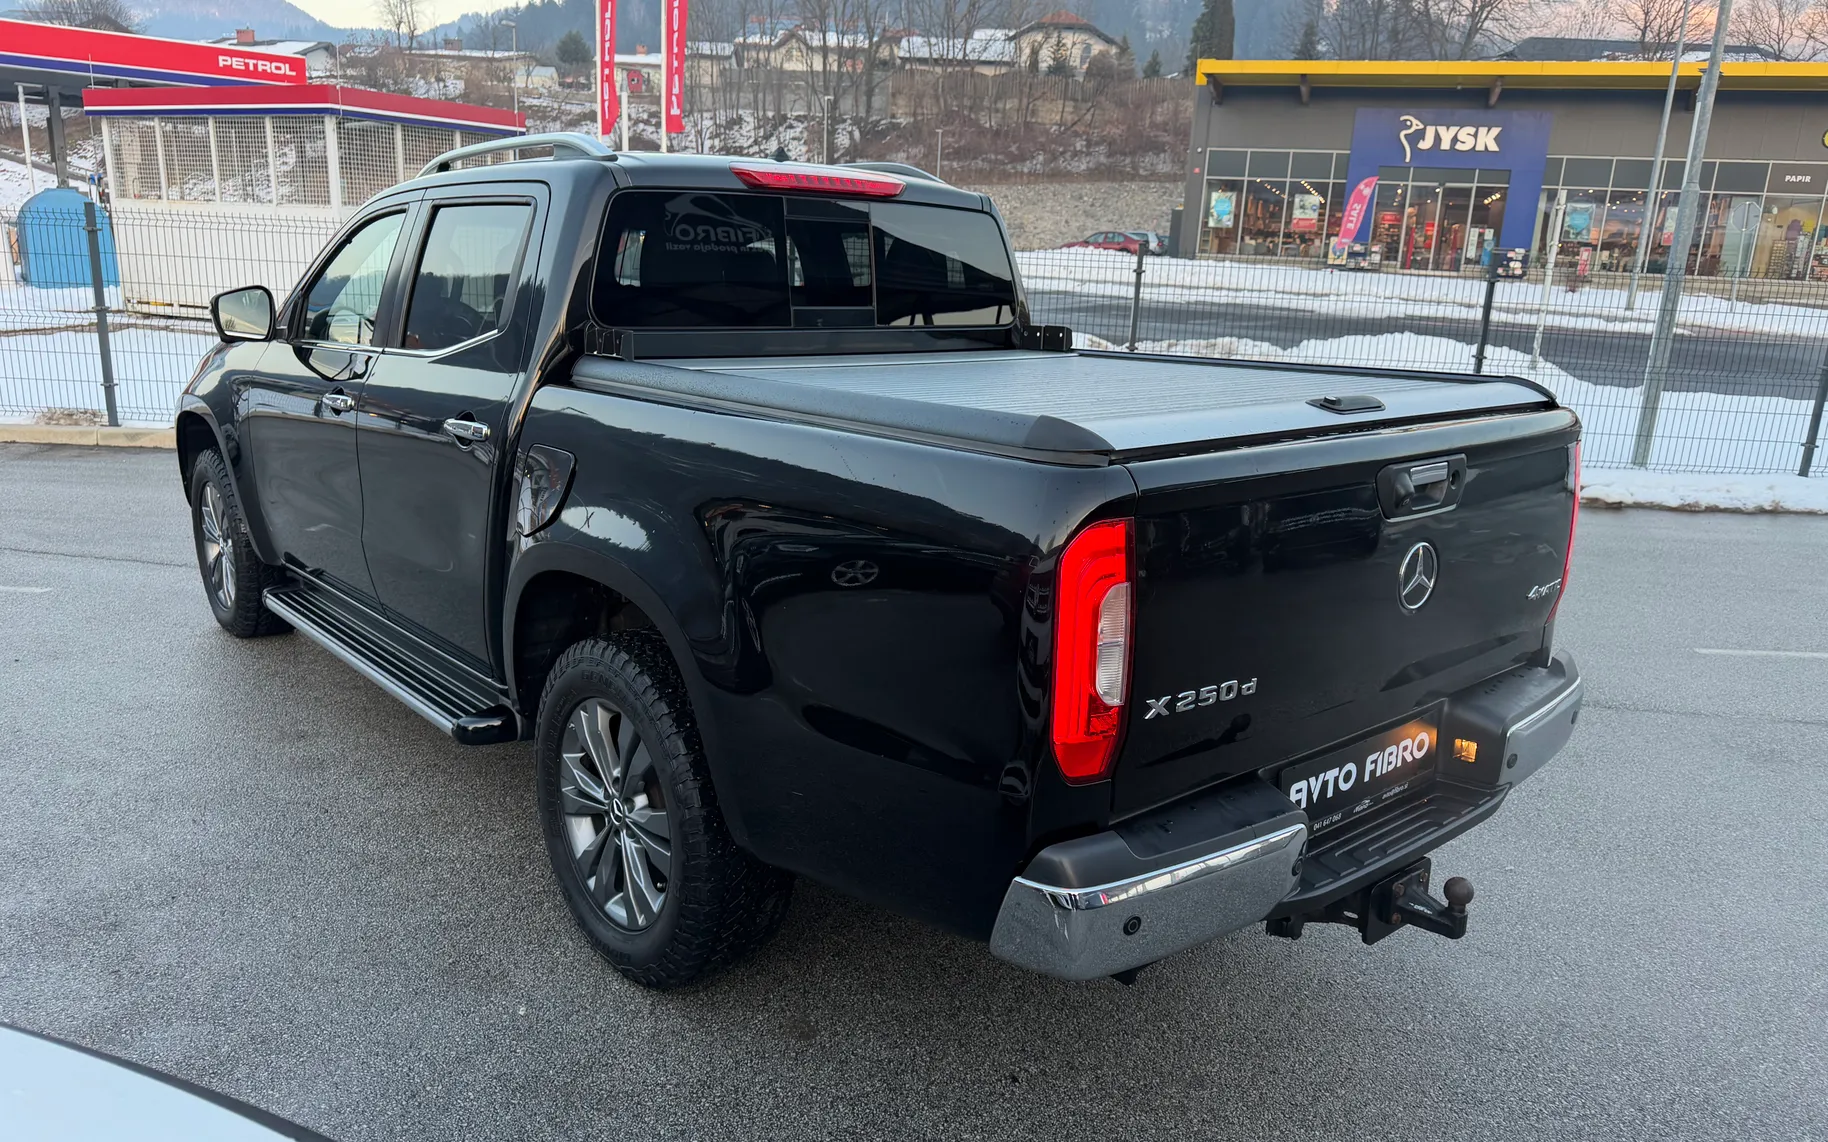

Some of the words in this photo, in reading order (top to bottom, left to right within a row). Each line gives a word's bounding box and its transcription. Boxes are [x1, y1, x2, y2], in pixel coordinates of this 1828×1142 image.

[218, 55, 297, 76] PETROL
[1416, 125, 1502, 152] JYSK
[1144, 695, 1172, 720] X
[1289, 762, 1358, 809] AVTO
[1363, 731, 1430, 782] FIBRO
